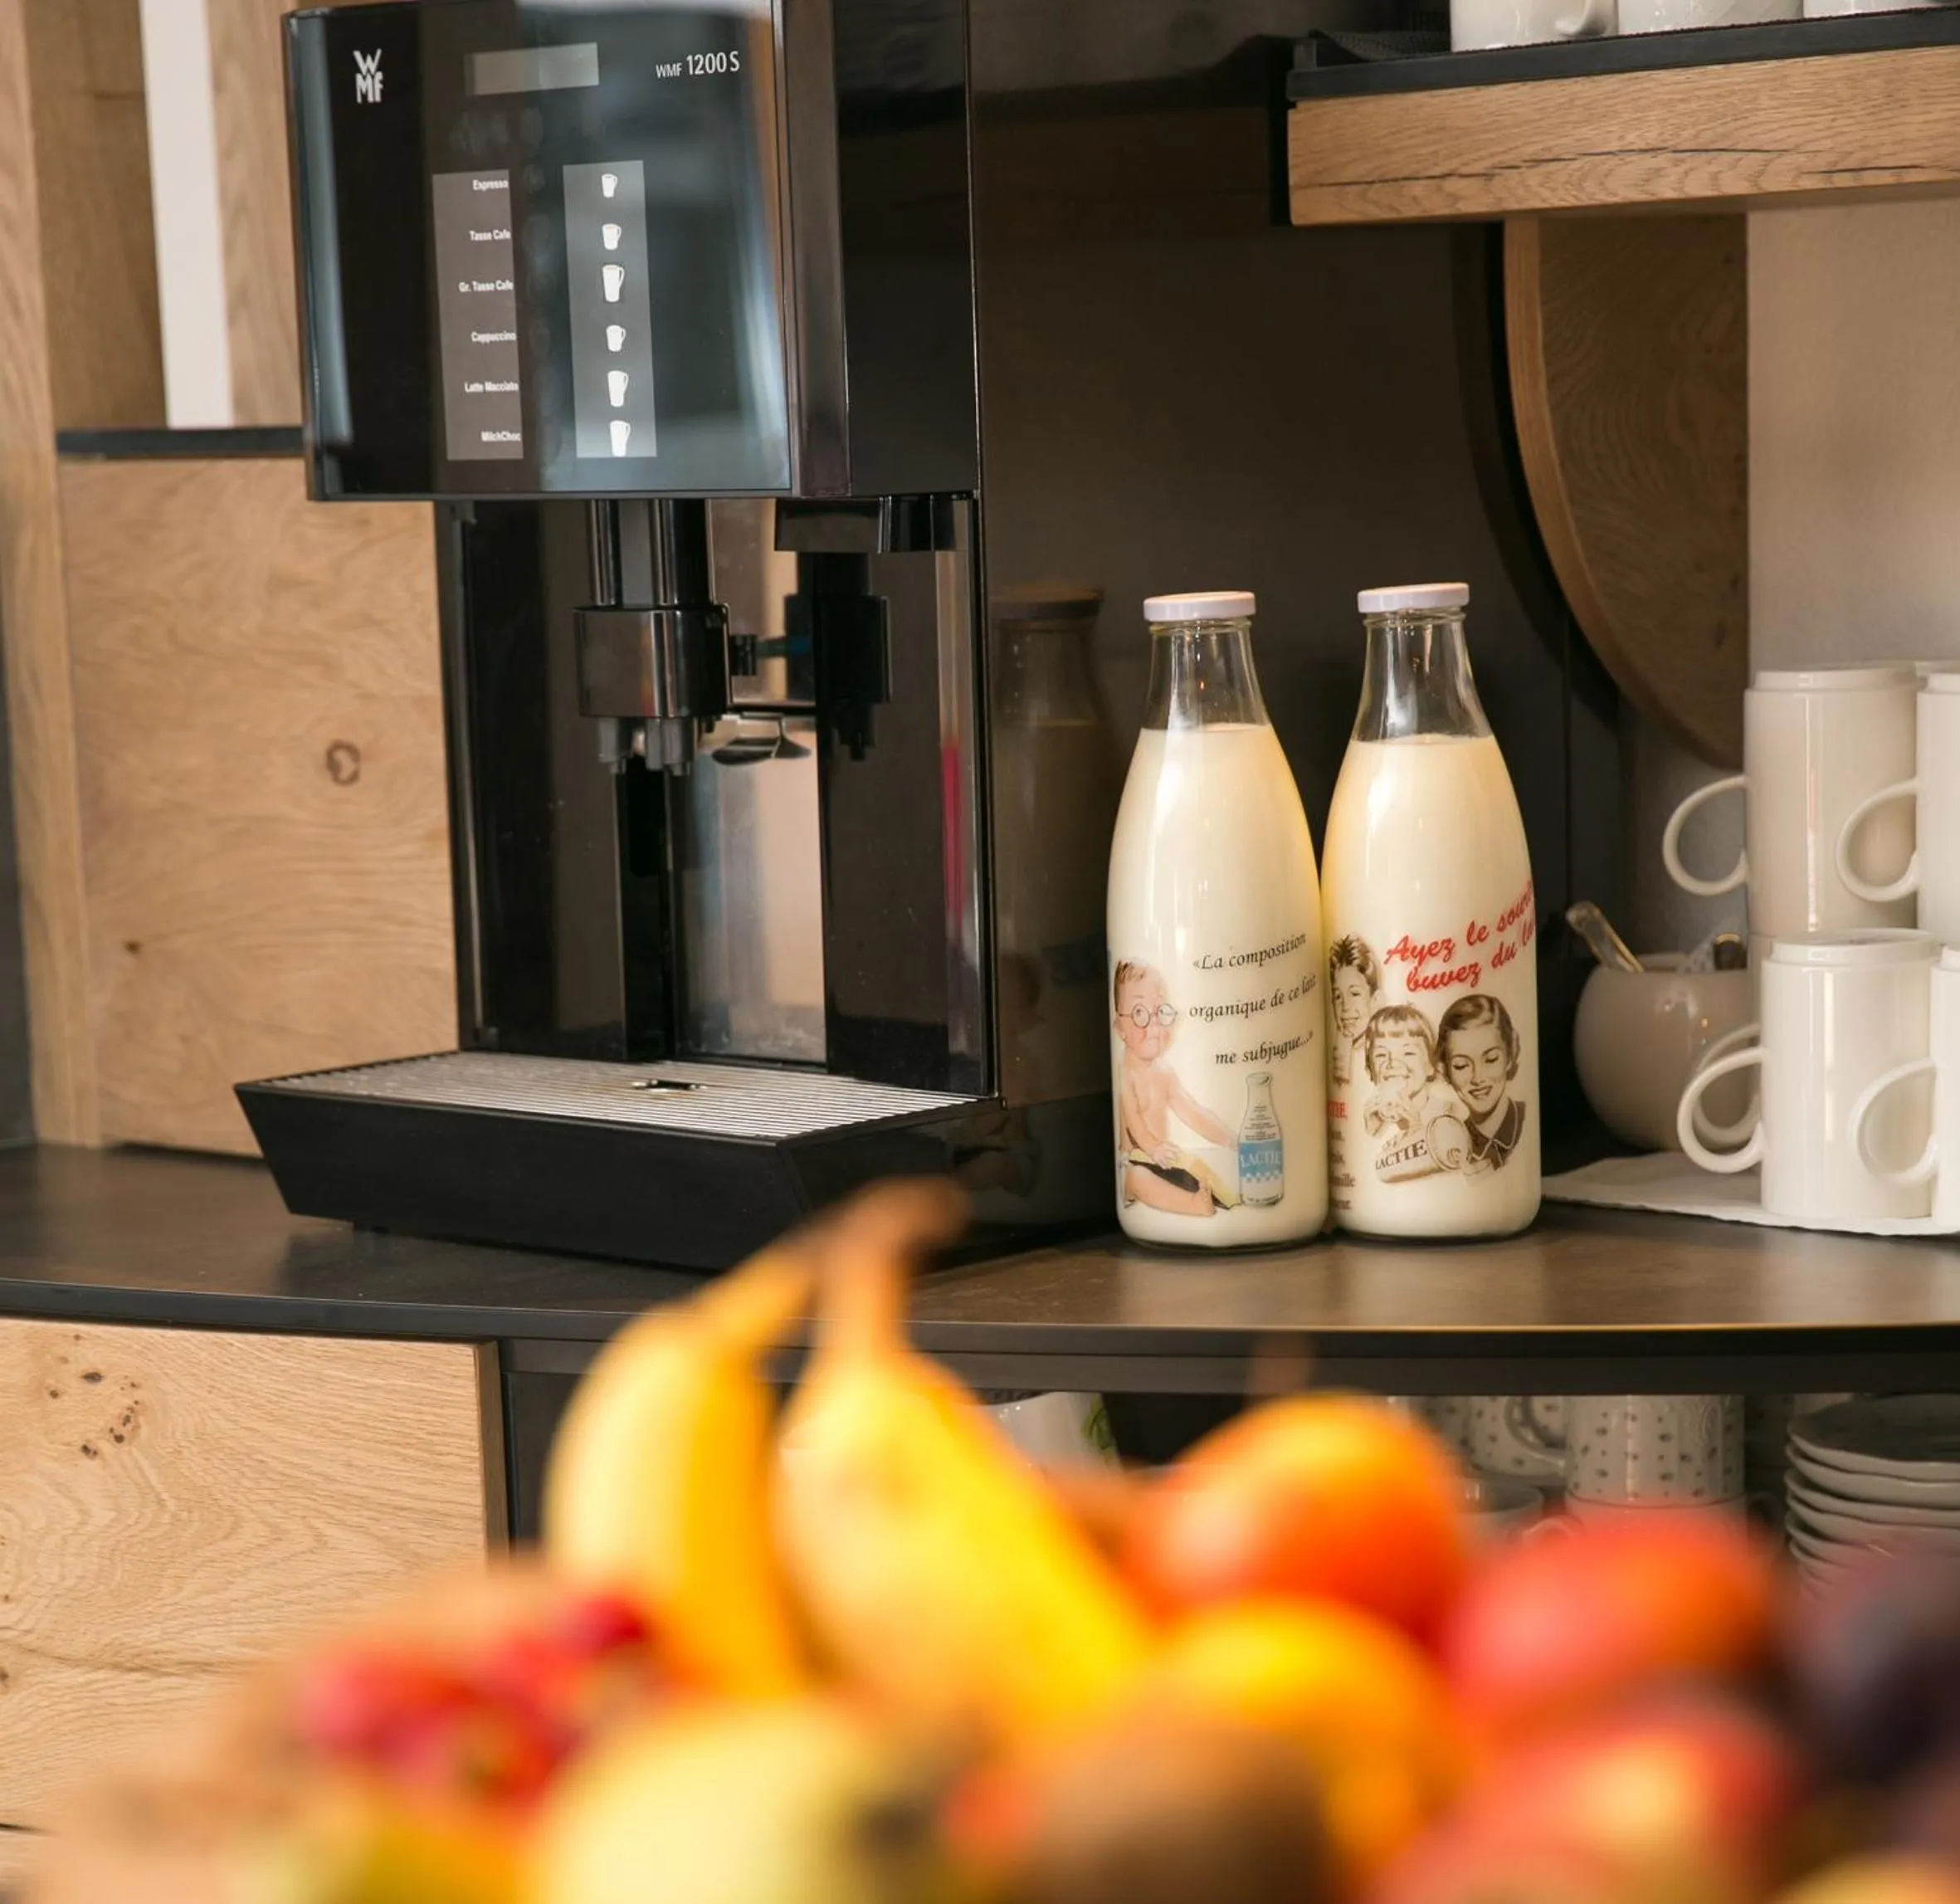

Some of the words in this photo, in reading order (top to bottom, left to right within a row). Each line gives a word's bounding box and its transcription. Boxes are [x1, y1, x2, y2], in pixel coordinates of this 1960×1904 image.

[655, 62, 682, 78] WMF
[686, 51, 727, 76] 1200
[729, 50, 740, 71] S
[458, 281, 471, 292] Gr.
[471, 281, 495, 292] Tasse
[470, 330, 516, 344] Cappuccino
[464, 381, 483, 393] Latte
[1229, 932, 1306, 968] composition
[1383, 934, 1456, 966] Ayez
[1466, 920, 1490, 947] le
[1407, 961, 1482, 992] buvez
[1491, 940, 1518, 969] du
[1189, 998, 1266, 1023] organique
[1270, 988, 1285, 1008] de
[1288, 986, 1300, 1002] ce
[1302, 974, 1317, 995] lait
[1215, 1052, 1237, 1065] me
